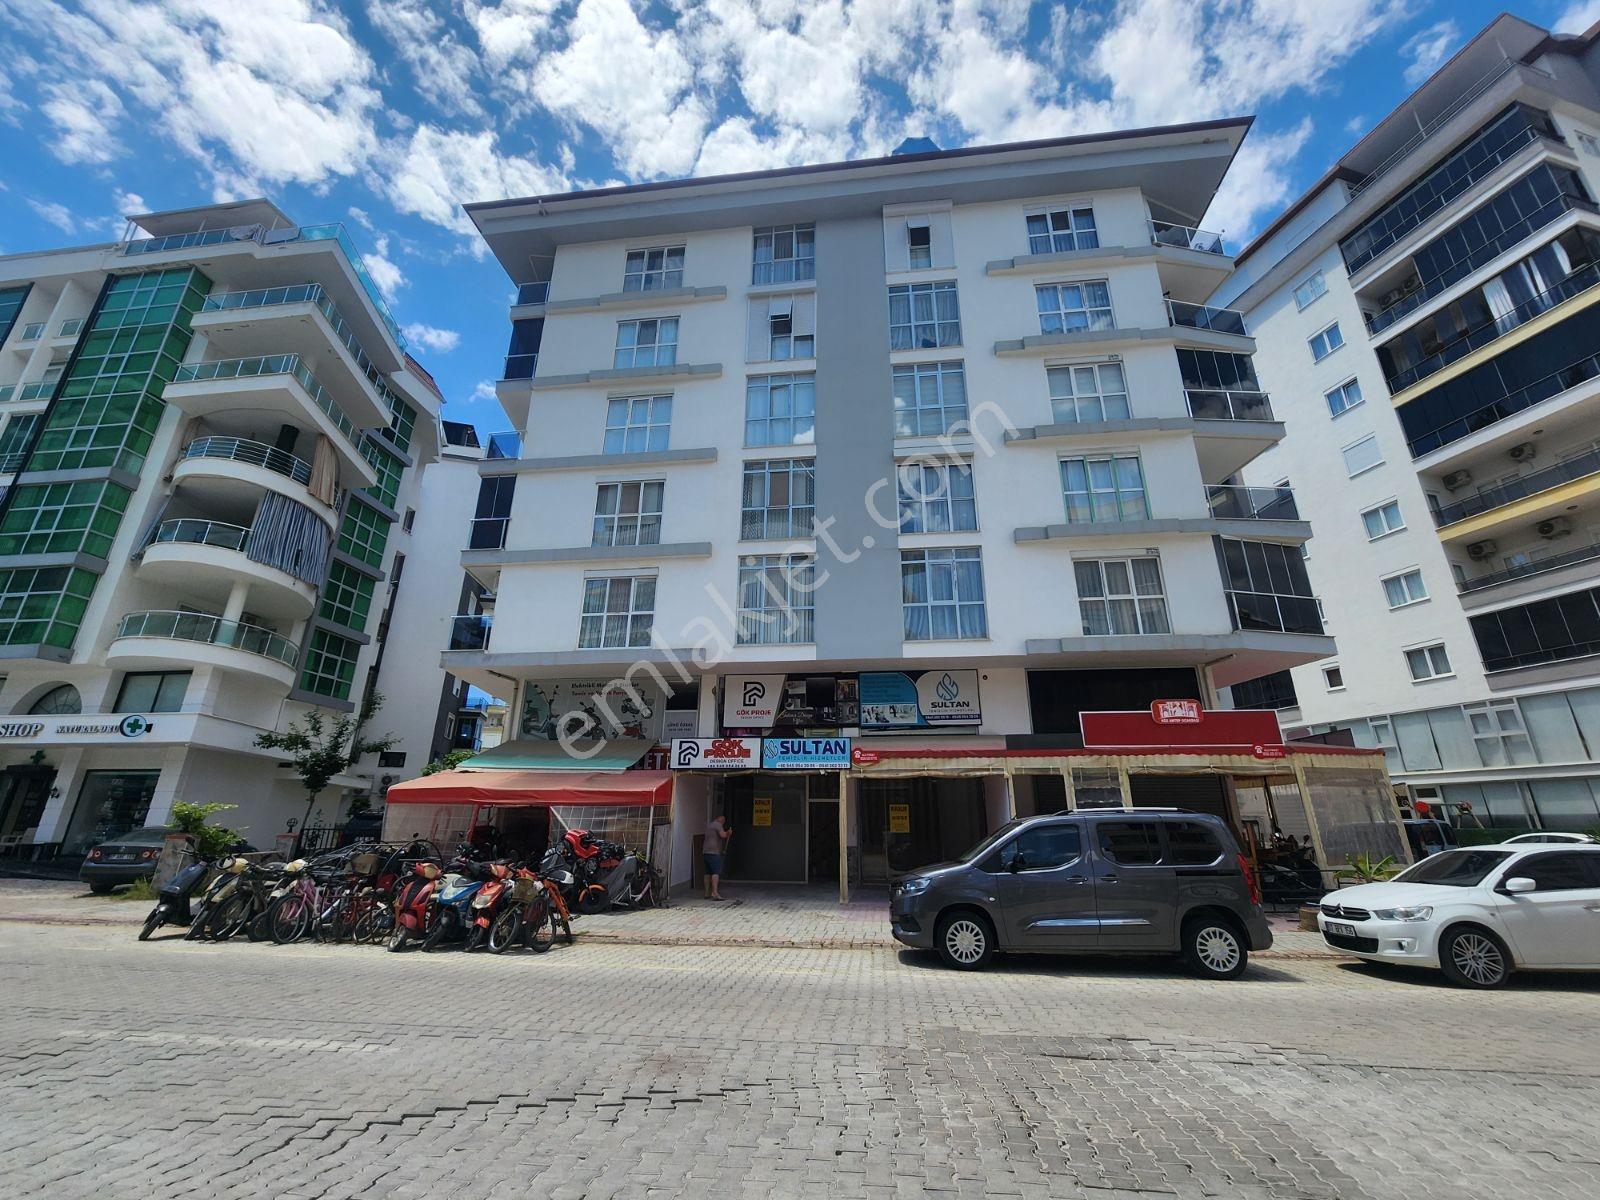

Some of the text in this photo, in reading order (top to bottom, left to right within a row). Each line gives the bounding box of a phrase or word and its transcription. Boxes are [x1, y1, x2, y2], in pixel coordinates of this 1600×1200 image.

[930, 700, 970, 708] SULTAN
[0, 723, 44, 738] SHOP
[711, 737, 744, 750] GÖK
[780, 740, 846, 755] SULTAN
[703, 748, 751, 759] PROJE
